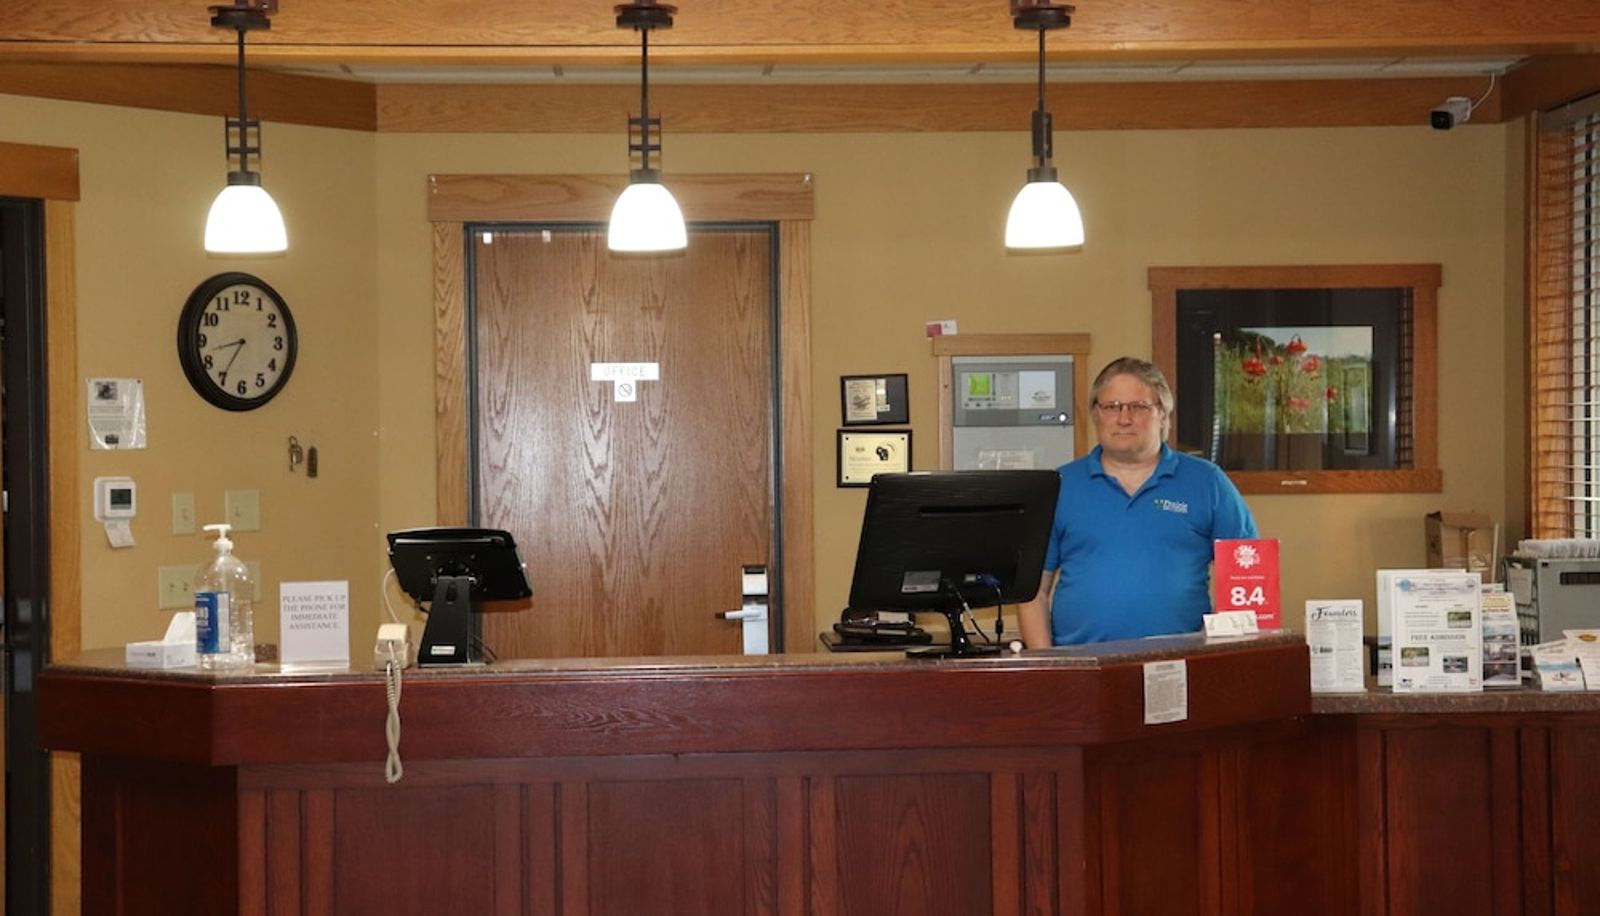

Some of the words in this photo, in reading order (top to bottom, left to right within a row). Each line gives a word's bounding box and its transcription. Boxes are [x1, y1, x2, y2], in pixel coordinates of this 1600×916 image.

[216, 297, 229, 311] 11
[233, 290, 250, 306] 12
[256, 297, 263, 311] 1
[203, 312, 219, 327] 10
[267, 313, 277, 328] 2
[198, 333, 207, 348] 9
[273, 336, 283, 351] 3
[203, 354, 213, 370] 8
[267, 357, 276, 371] 4
[603, 365, 647, 377] OFFICE
[218, 371, 228, 387] 7
[255, 372, 265, 388] 5
[237, 380, 247, 395] 6
[1230, 586, 1265, 606] 8.4
[291, 612, 337, 620] IMMEDIATE
